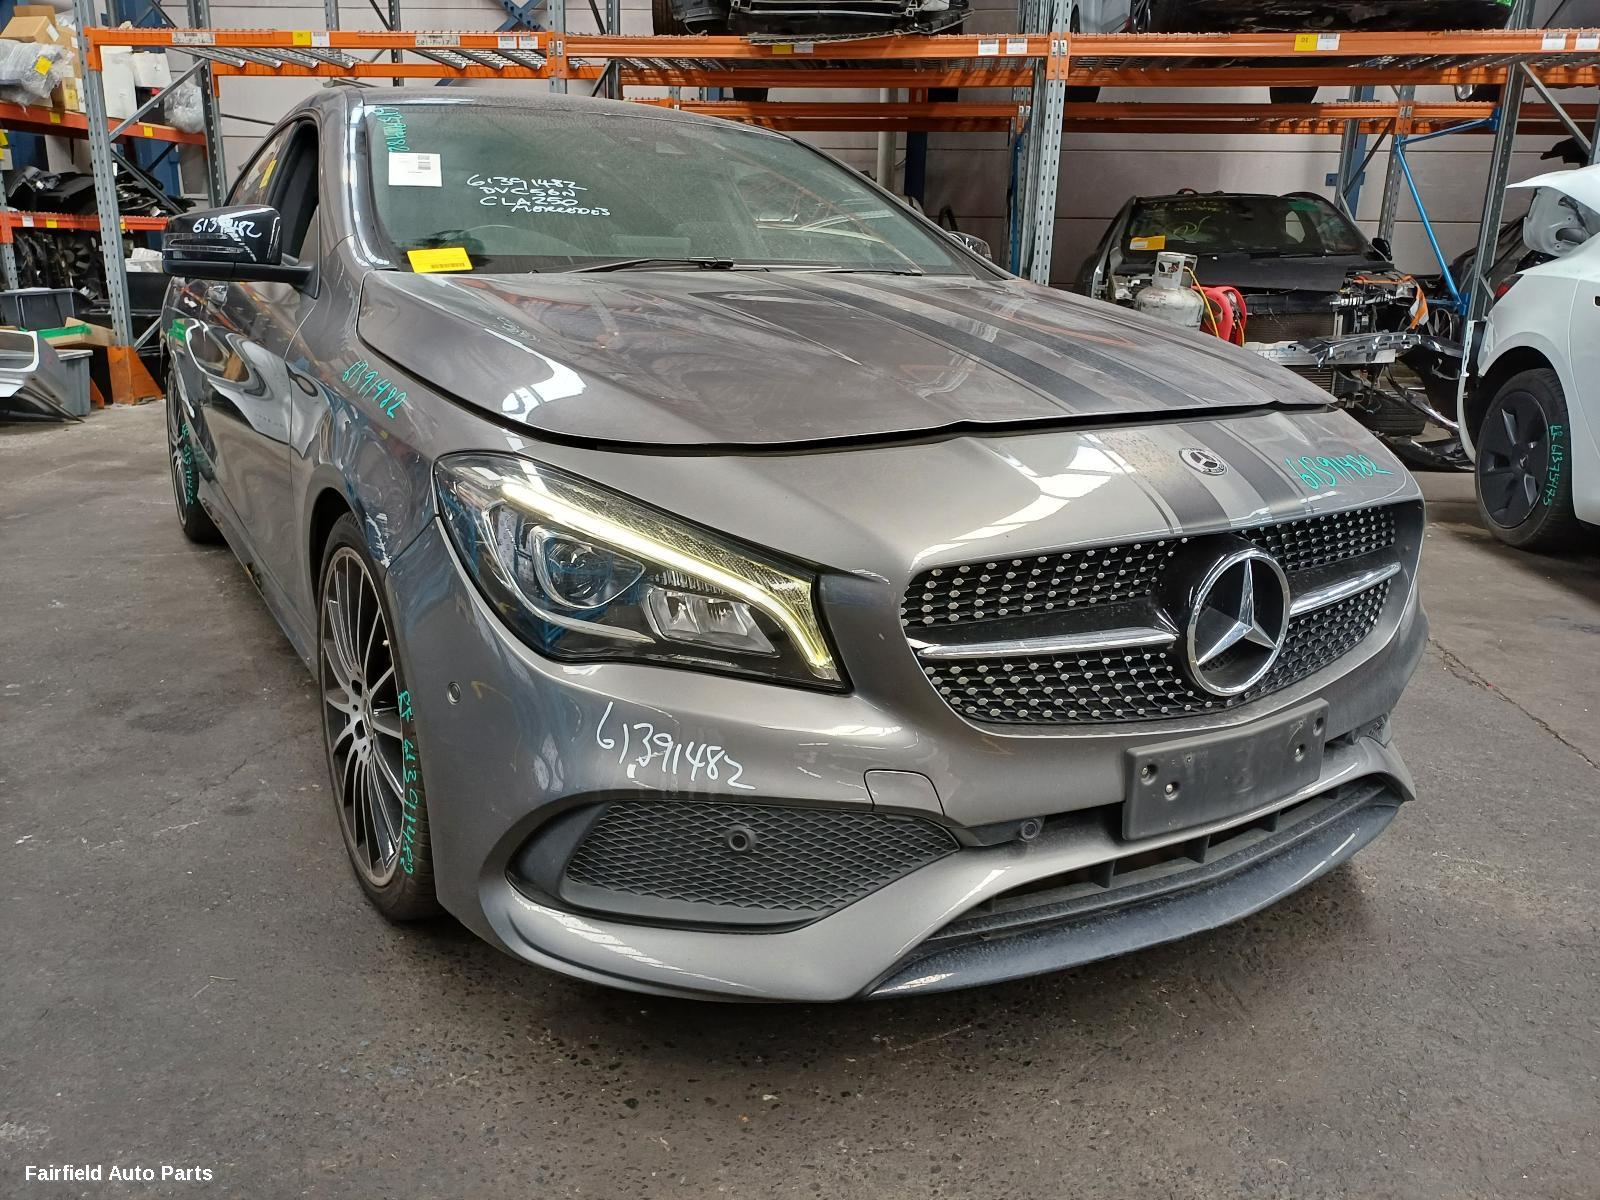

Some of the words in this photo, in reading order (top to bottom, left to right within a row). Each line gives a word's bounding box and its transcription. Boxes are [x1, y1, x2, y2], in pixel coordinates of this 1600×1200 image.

[466, 174, 588, 191] 61391482
[1284, 454, 1395, 490] 61391482
[595, 700, 756, 790] 61391482
